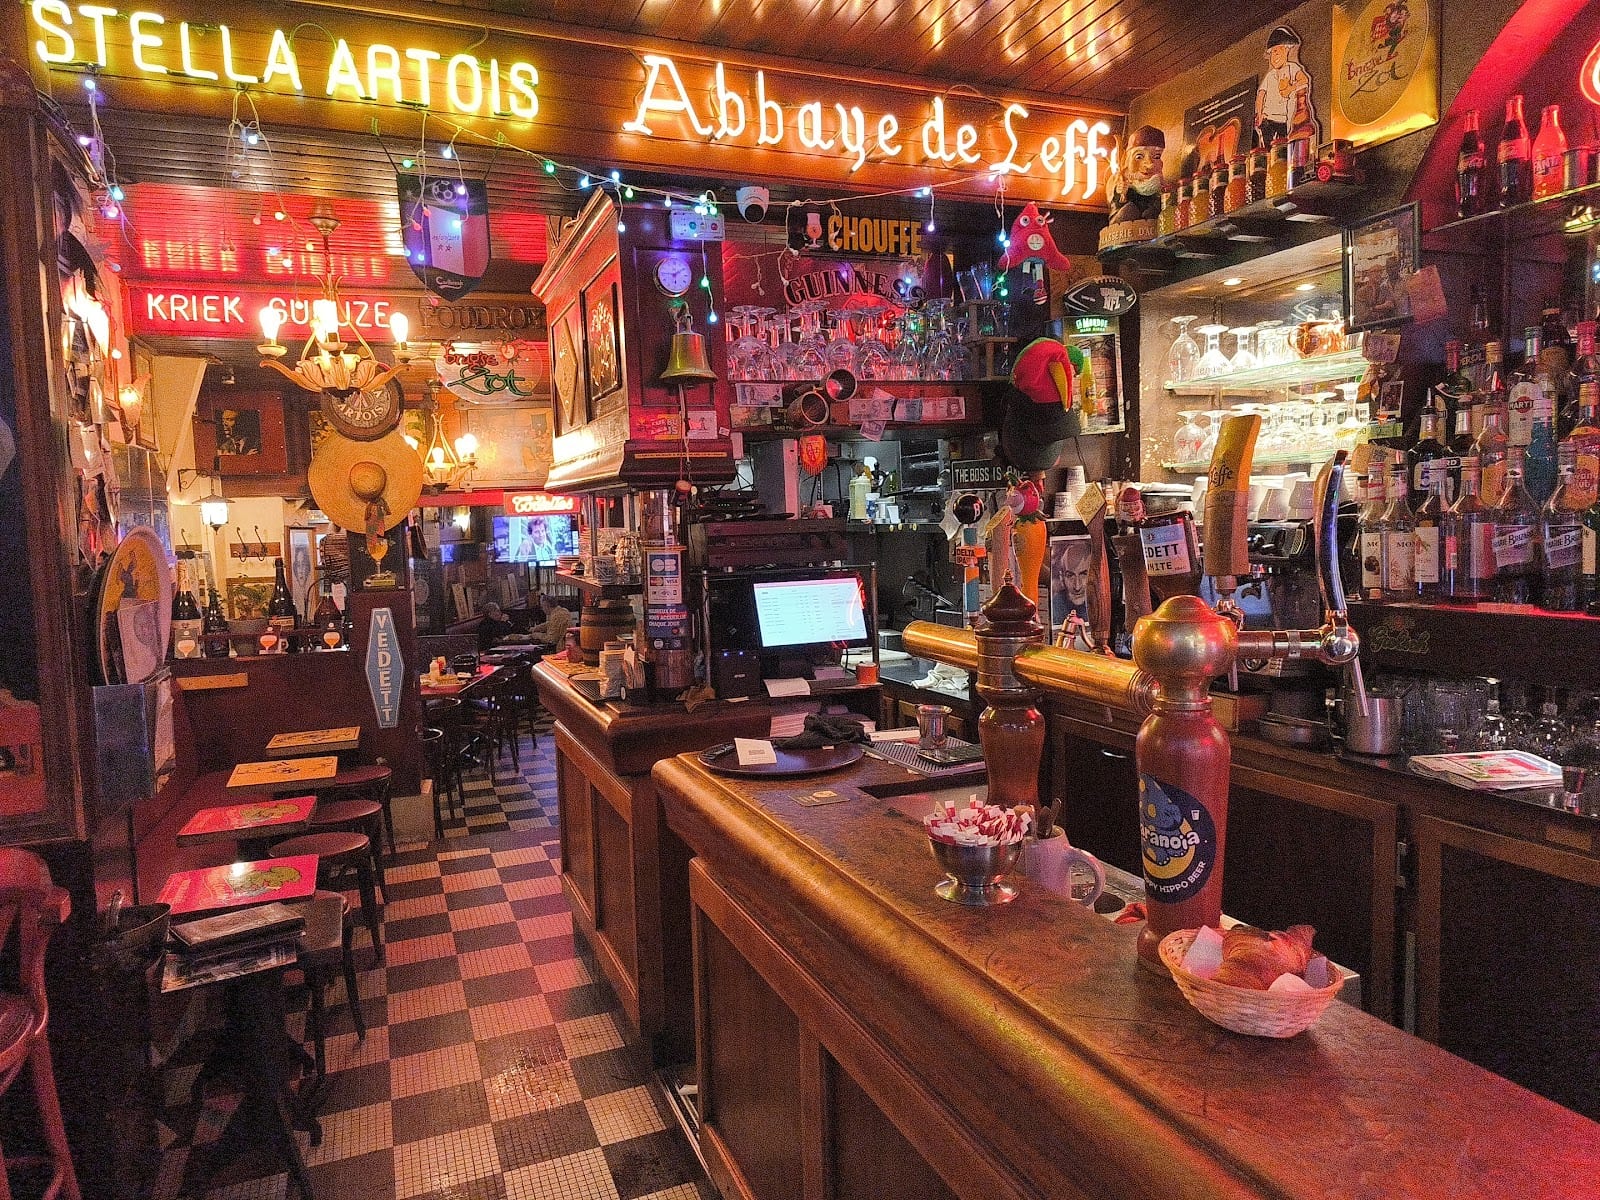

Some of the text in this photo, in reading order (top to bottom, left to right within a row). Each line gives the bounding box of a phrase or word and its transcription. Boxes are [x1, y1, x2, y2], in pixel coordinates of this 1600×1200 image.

[32, 0, 540, 119] STELLA ARTOIS
[622, 54, 903, 172] Abbaye
[921, 96, 981, 163] de
[828, 215, 922, 256] CHOUFFE
[784, 268, 927, 311] GUINNESS
[1102, 296, 1121, 312] NFL
[147, 293, 390, 328] KRIEK GUUZE
[447, 365, 532, 396] Zot
[337, 404, 384, 421] ARTOIS
[955, 469, 969, 483] THE
[970, 467, 989, 482] BOSS
[993, 466, 1002, 480] IS
[1210, 464, 1234, 487] Leffe
[651, 558, 677, 572] CB
[957, 548, 976, 556] DELTA
[376, 615, 392, 722] VEDETT
[1160, 880, 1189, 893] HIPPO
[1187, 861, 1206, 884] BEER
